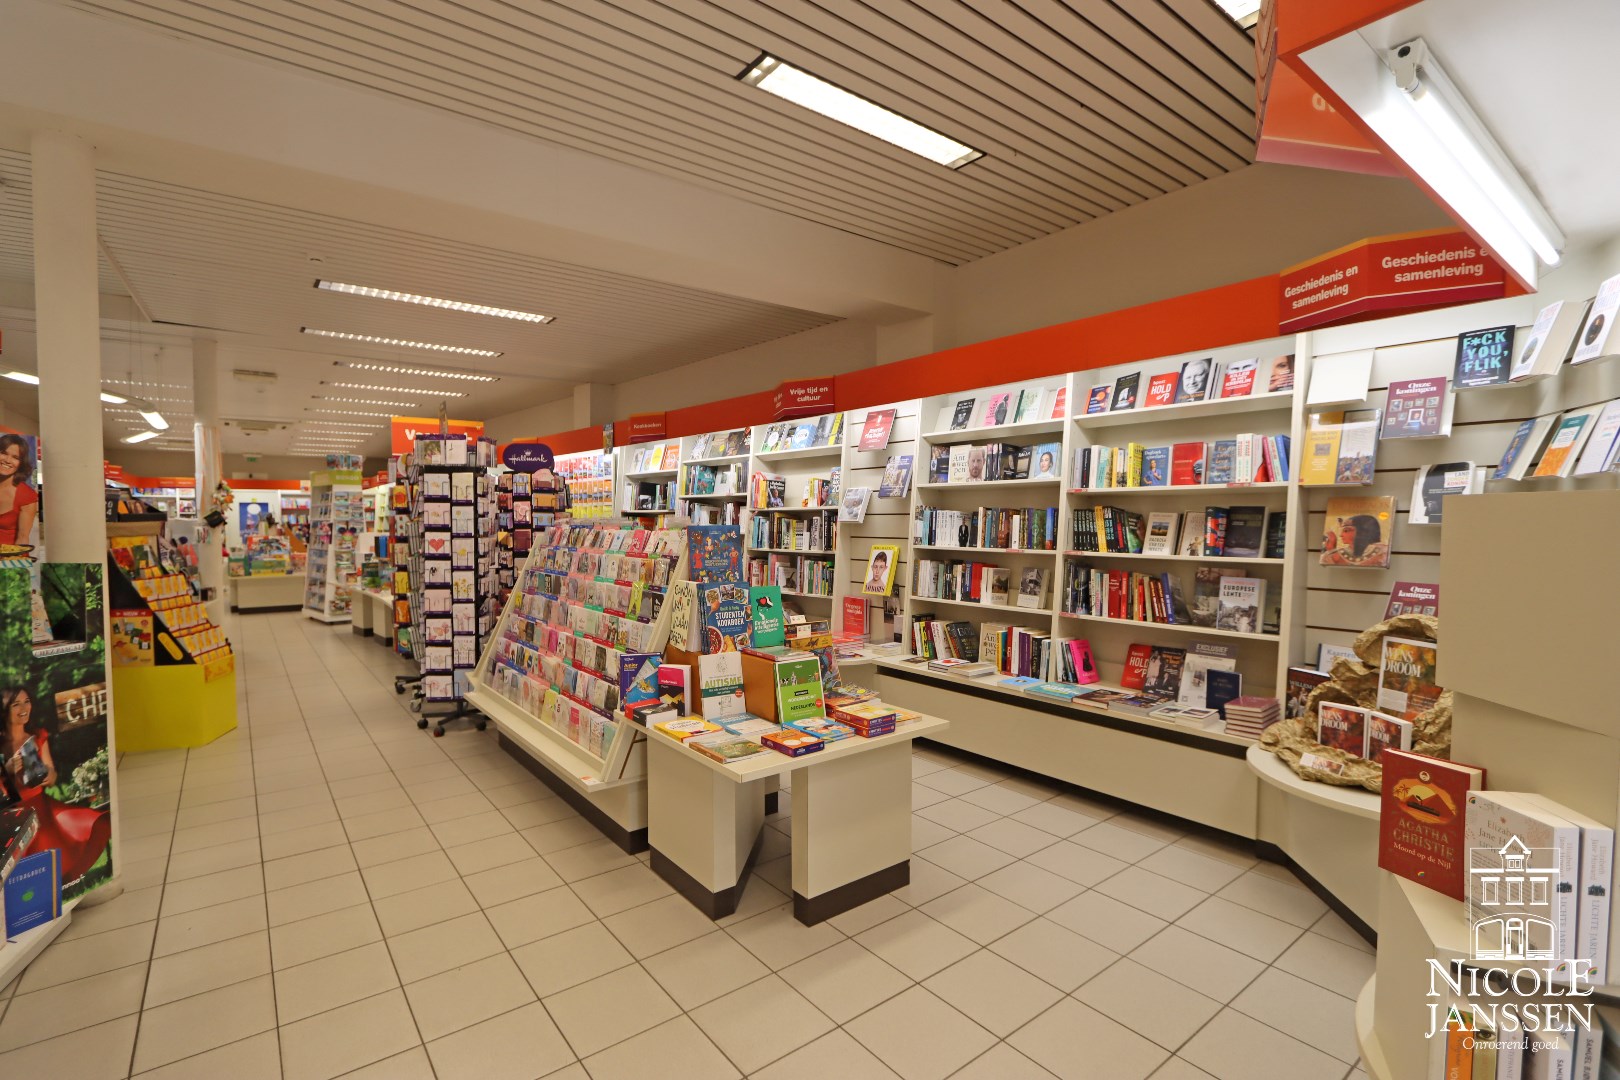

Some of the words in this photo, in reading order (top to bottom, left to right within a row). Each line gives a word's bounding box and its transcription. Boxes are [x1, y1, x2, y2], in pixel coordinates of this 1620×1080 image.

[1382, 246, 1476, 269] Geschiedenis
[1394, 262, 1484, 283] samenleving
[1284, 270, 1344, 298] Geschiedenis
[1345, 265, 1359, 277] en
[1292, 283, 1349, 309] samenleving
[1467, 343, 1509, 360] YOU,
[1464, 356, 1502, 373] FLIK
[790, 388, 806, 397] Vrije
[807, 386, 818, 395] tijd
[1151, 384, 1172, 395] HOLD
[1396, 386, 1437, 395] koningen
[508, 453, 548, 465] Hallmark
[1398, 589, 1436, 601] koningen
[1410, 585, 1432, 594] Onze
[715, 610, 745, 620] STUDENTEN
[717, 618, 745, 627] KOOKBOEK
[1196, 643, 1229, 653] EXCLUSIEF
[1384, 646, 1414, 663] WENS
[1129, 656, 1149, 667] HOLD
[1385, 659, 1421, 678] DROOM
[704, 676, 743, 690] AUTISME
[1320, 708, 1343, 721] WENS
[1321, 719, 1348, 732] DROOM
[1399, 818, 1449, 844] AGATHA
[1479, 828, 1496, 841] Jane
[1393, 827, 1455, 862] CHRISTIE
[1393, 842, 1416, 856] Moord
[1417, 852, 1426, 860] op
[1437, 858, 1451, 870] Nijl
[1591, 900, 1600, 932] LICHTE
